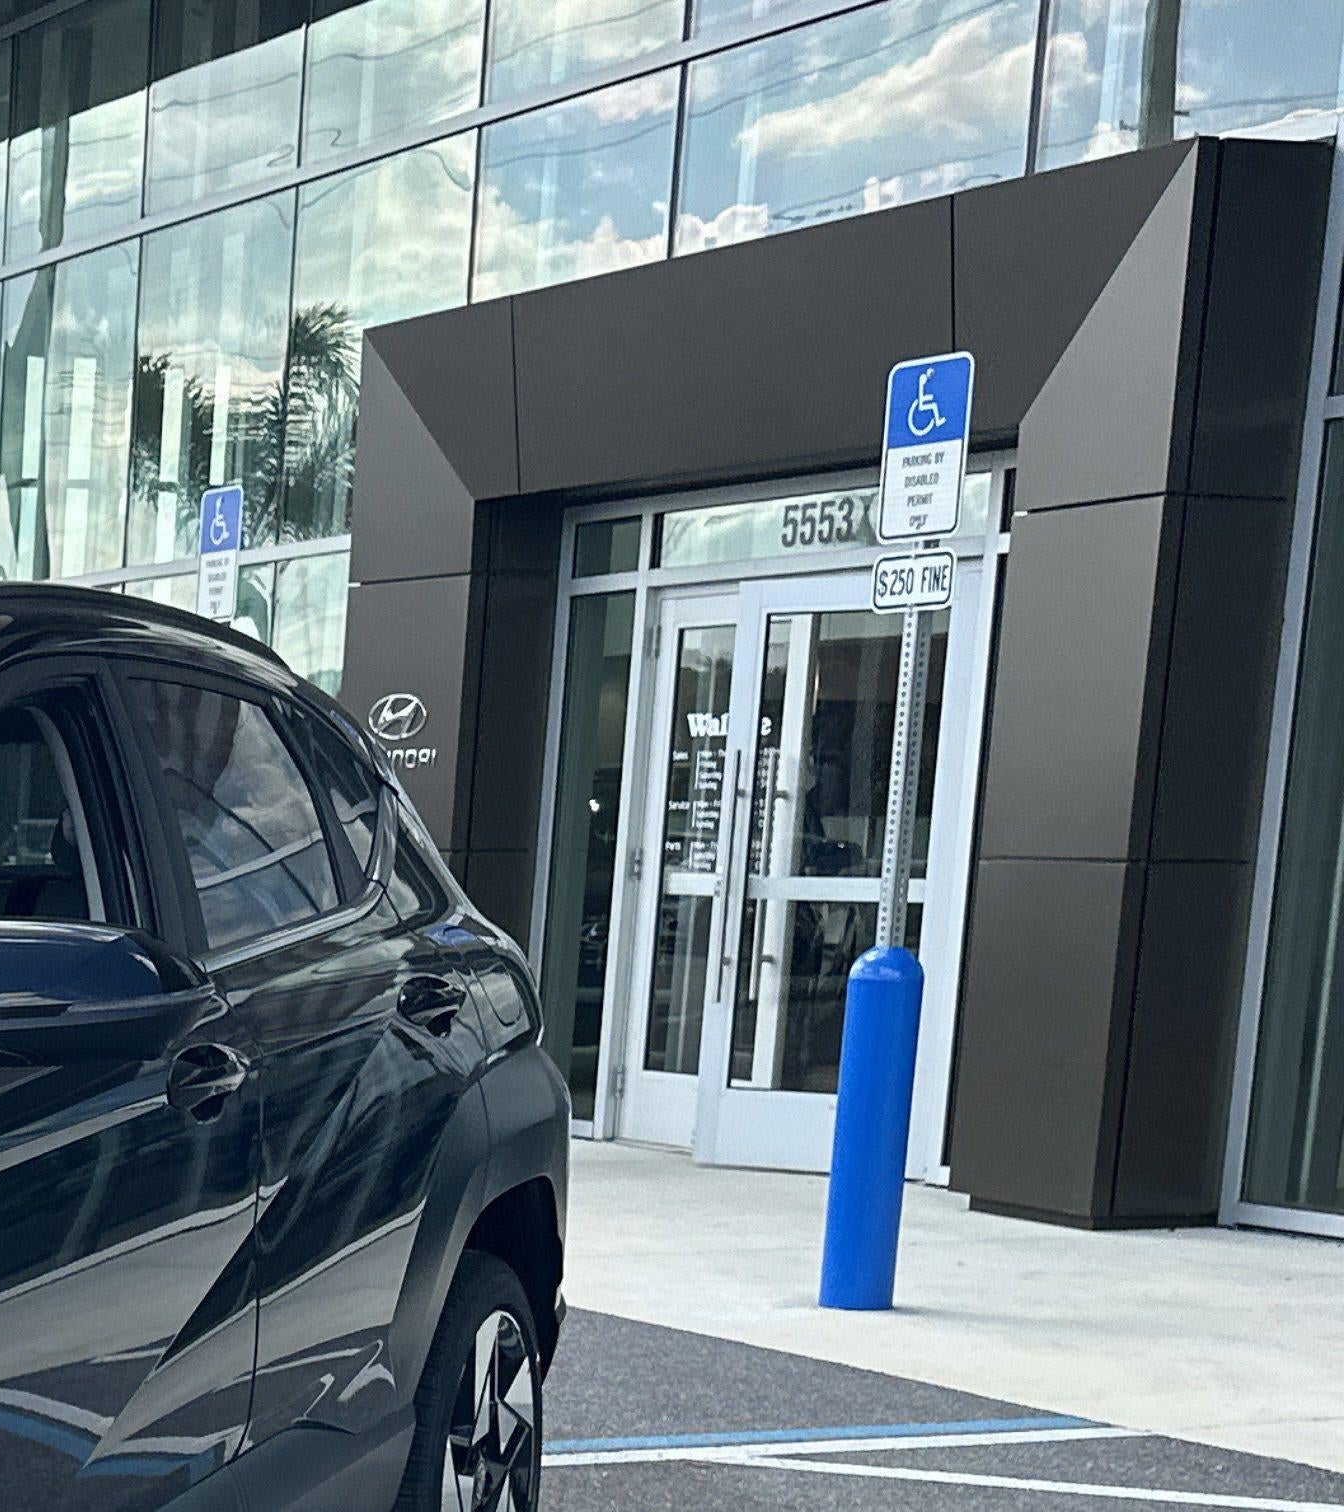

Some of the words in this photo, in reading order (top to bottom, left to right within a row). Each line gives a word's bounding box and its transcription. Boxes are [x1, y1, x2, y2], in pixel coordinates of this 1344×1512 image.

[902, 452, 932, 469] PARKING
[934, 451, 945, 465] BY
[904, 472, 939, 489] DISABLED
[907, 493, 933, 507] PERMIT
[781, 496, 854, 548] 5553
[877, 567, 914, 598] $250
[920, 564, 950, 594] FINE
